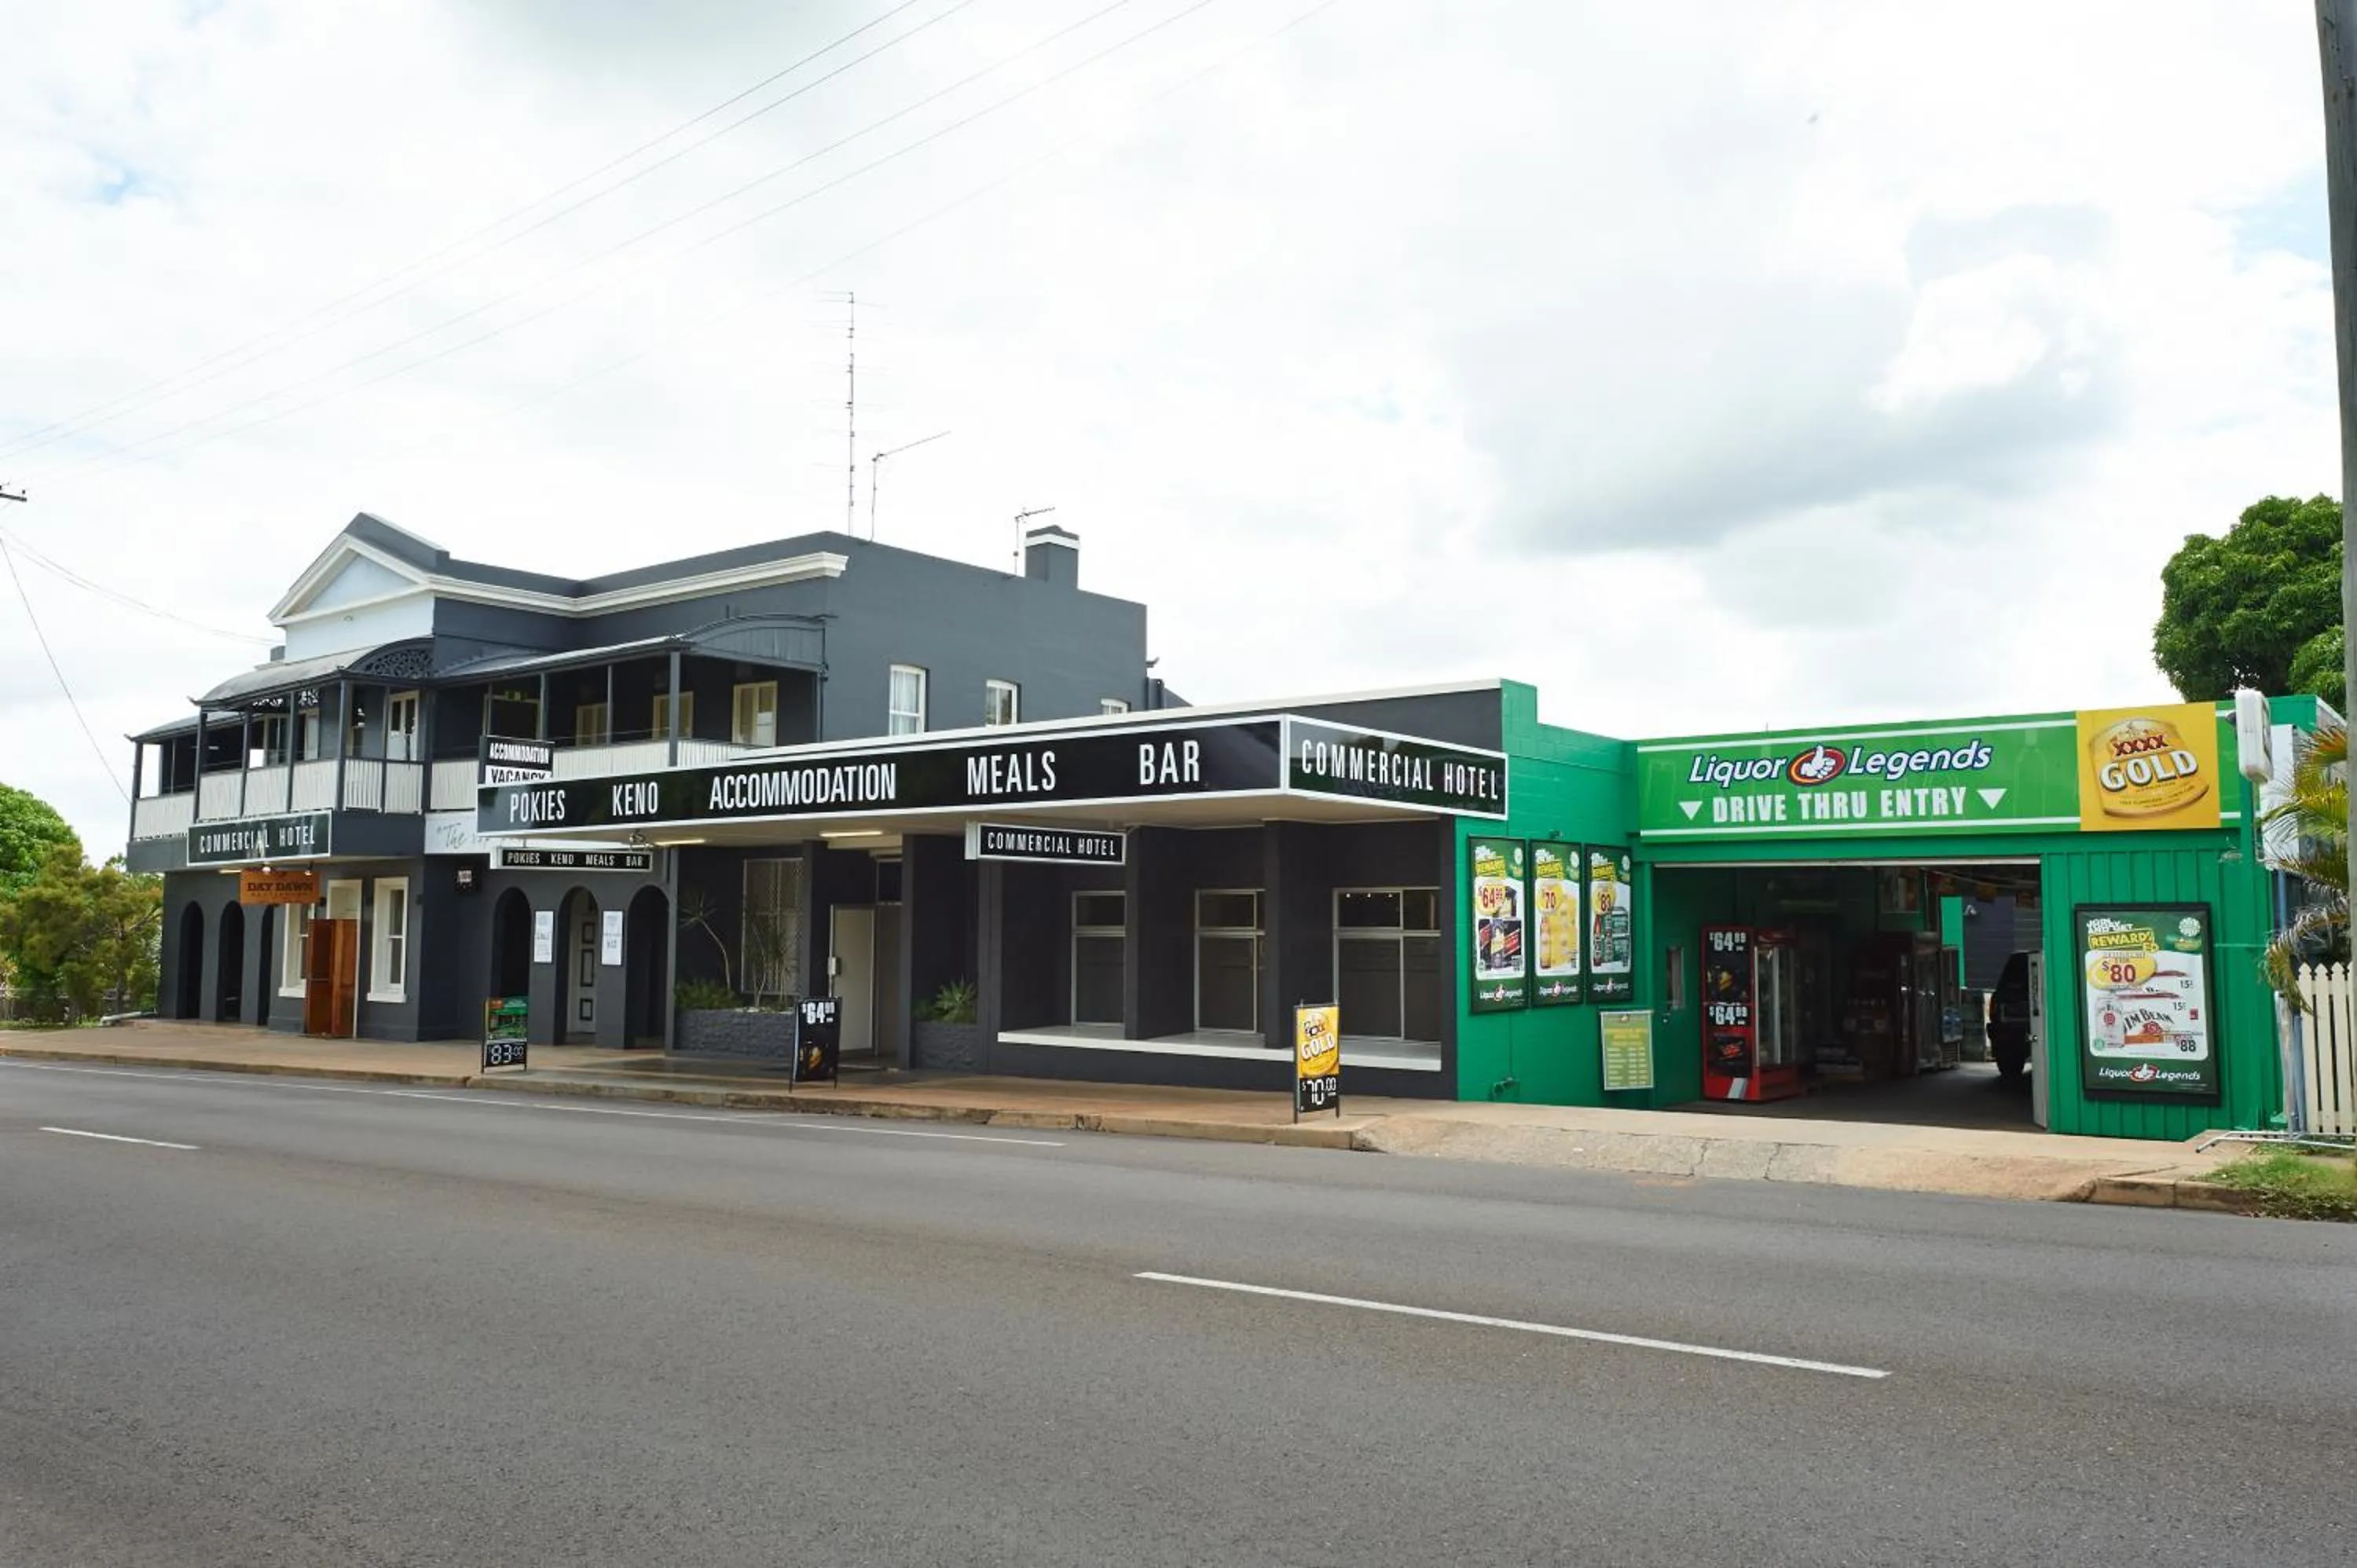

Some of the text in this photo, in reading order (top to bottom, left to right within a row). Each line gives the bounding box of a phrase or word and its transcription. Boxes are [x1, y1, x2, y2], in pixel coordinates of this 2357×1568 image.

[489, 742, 549, 764] ACCOMMODATION
[1688, 739, 1992, 788] Liquor Legends
[510, 740, 1200, 822] POKIES KENO ACCOMMODATION MEALS BAR
[1302, 738, 1499, 801] COMMERCIAL HOTEL
[2099, 750, 2198, 792] GOLD
[1713, 787, 1967, 823] DRIVE THRU ENTRY
[200, 825, 315, 854] COMMERCIAL HOTEL
[988, 832, 1116, 855] COMMERCIAL HOTEL
[507, 852, 643, 866] POKIES KENO MEALS BAR
[1301, 1032, 1335, 1061] GOLD
[2156, 1068, 2201, 1082] Legends
